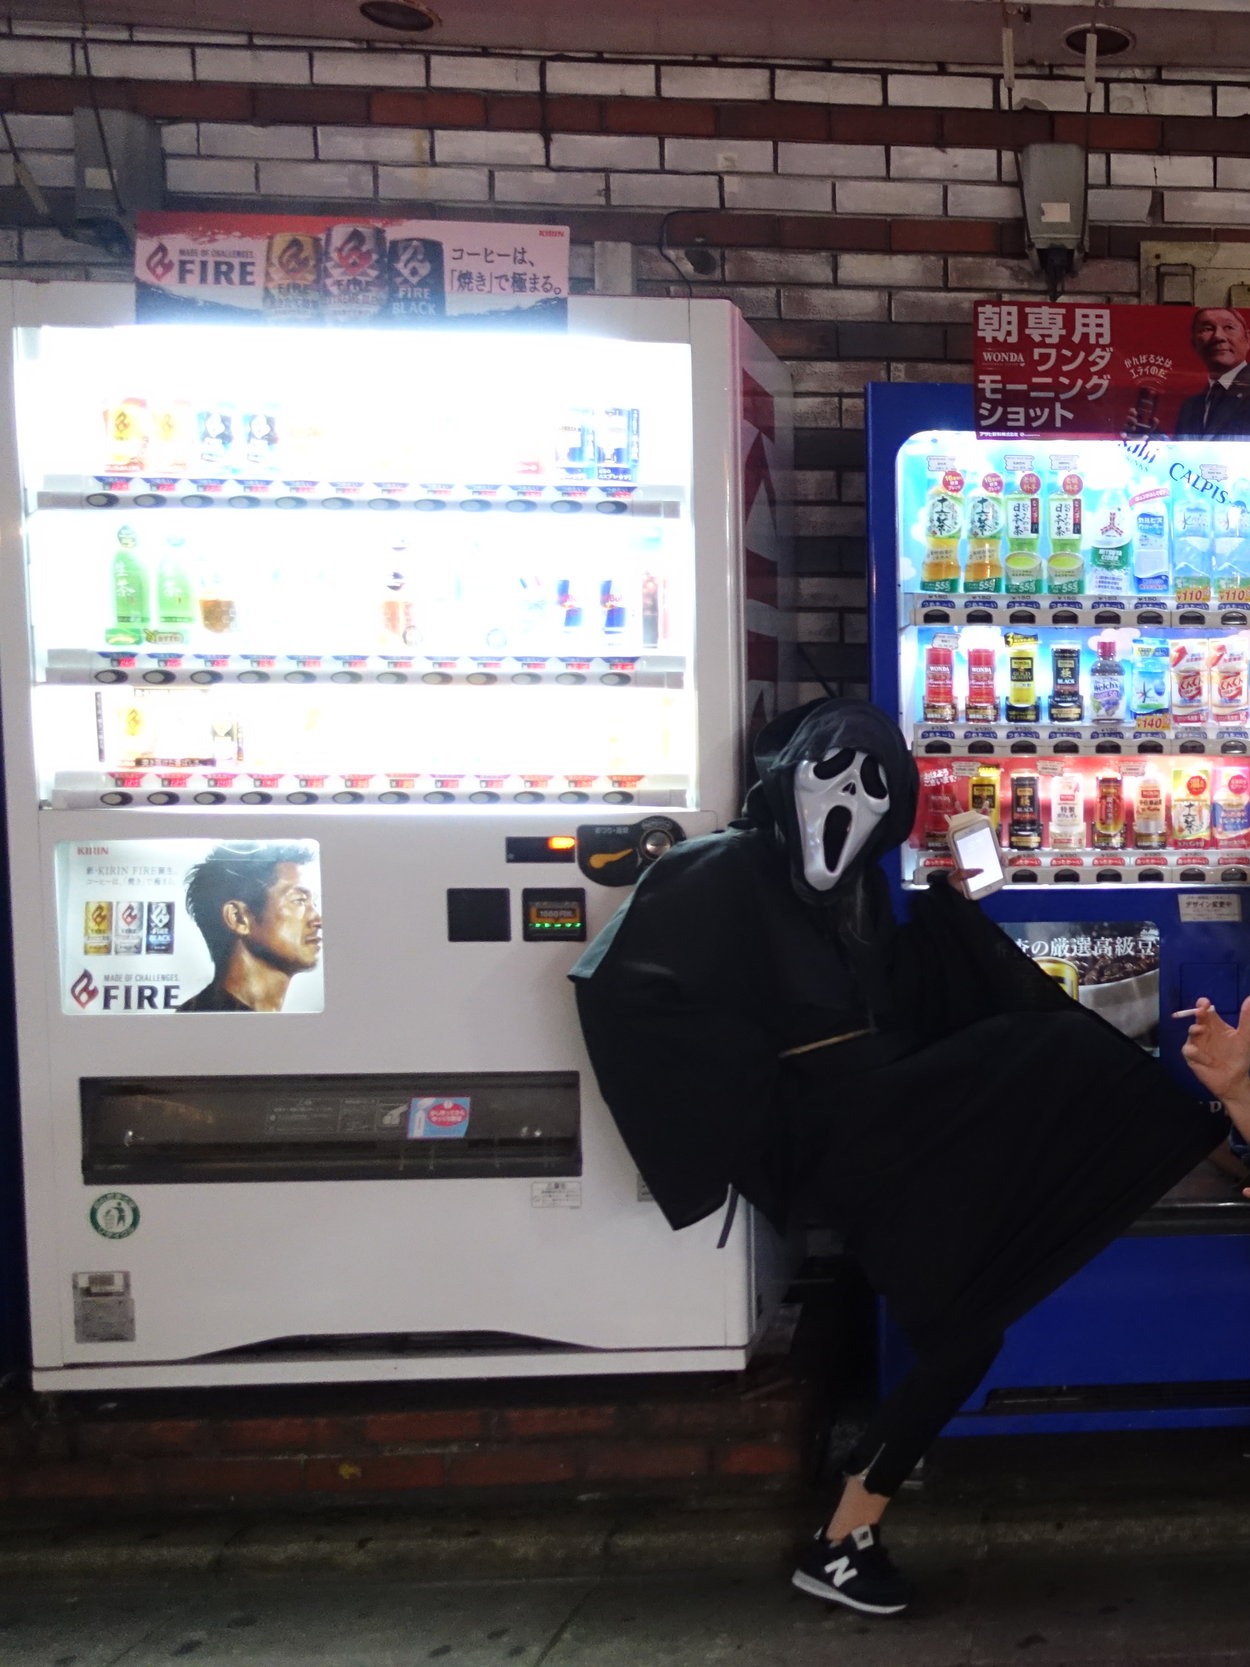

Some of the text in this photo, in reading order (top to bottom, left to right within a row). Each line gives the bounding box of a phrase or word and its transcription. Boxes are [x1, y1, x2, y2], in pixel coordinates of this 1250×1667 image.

[452, 247, 535, 267] コーヒーは、
[178, 260, 256, 286] FIRE
[399, 287, 431, 299] FIRE
[392, 303, 437, 315] BLACK
[977, 305, 1111, 344] 朝専用
[983, 352, 1026, 363] WONDA
[1033, 347, 1114, 372] ワンダ
[977, 375, 1111, 400] モーニング
[979, 402, 1074, 428] ショット
[1169, 462, 1231, 504] CALPIS
[77, 847, 109, 856] KIRIN
[104, 974, 122, 982] MADE
[125, 974, 133, 982] OF
[102, 985, 181, 1010] FIRE
[823, 1555, 858, 1588] N
